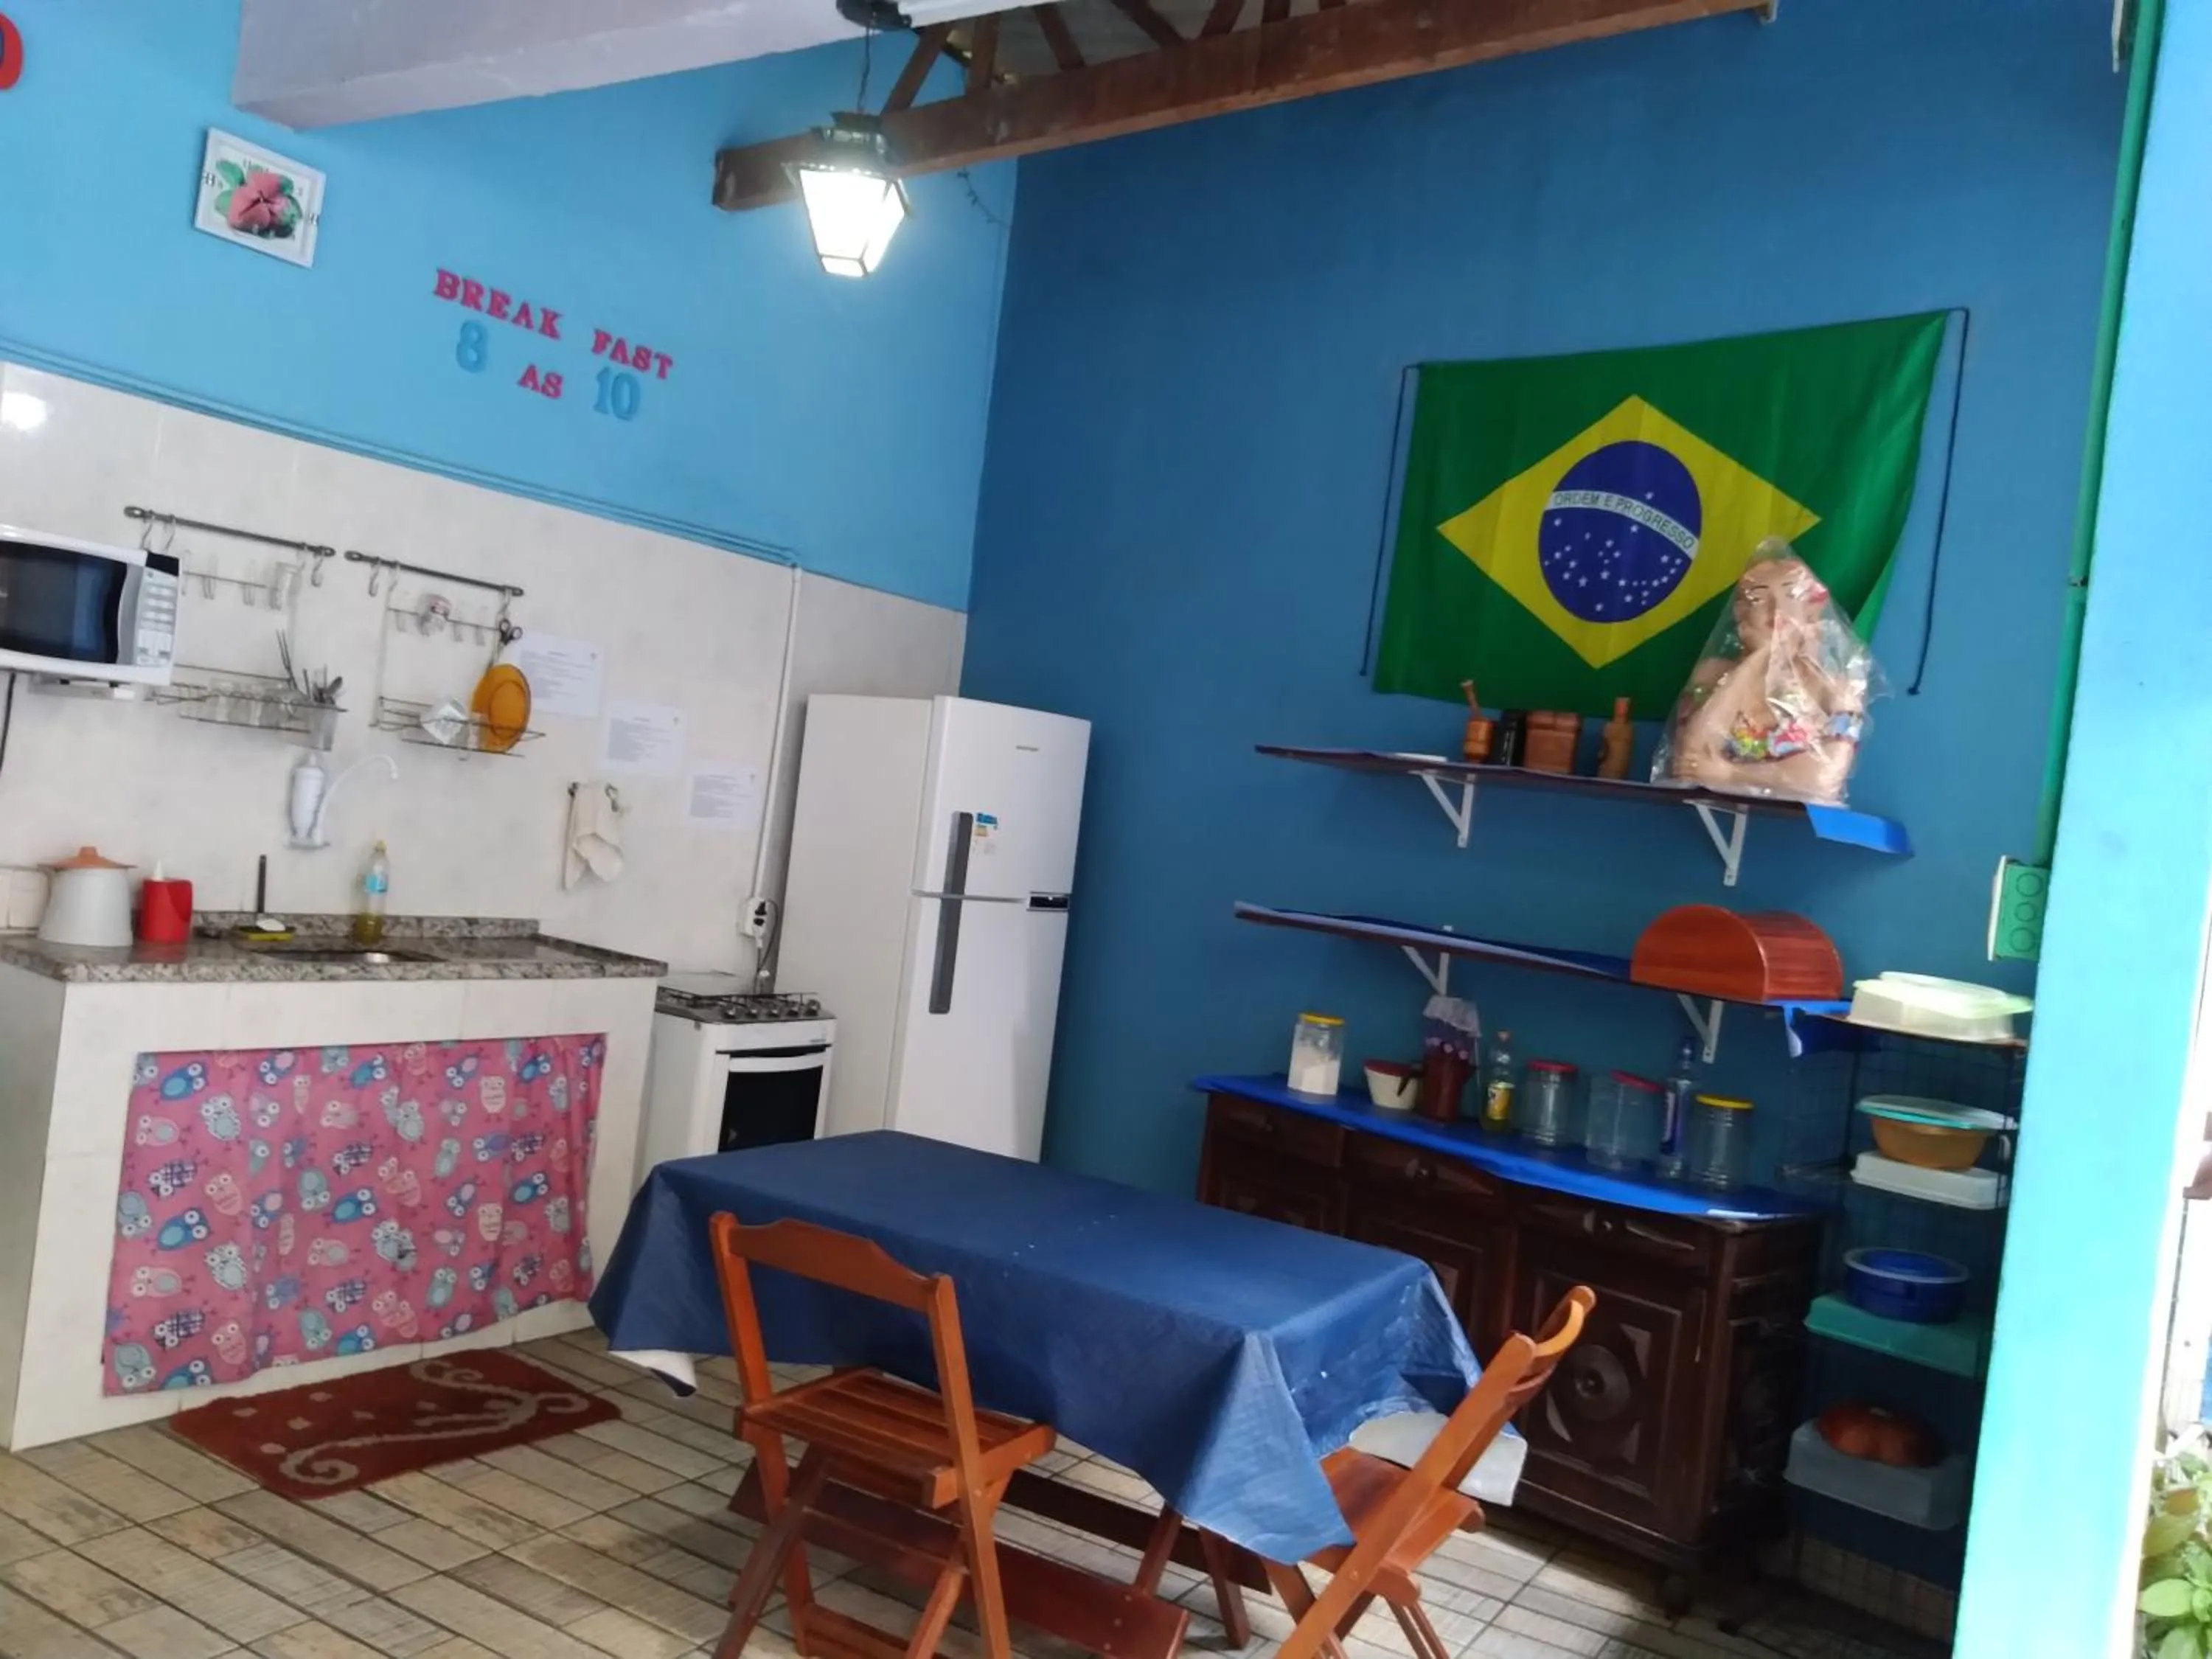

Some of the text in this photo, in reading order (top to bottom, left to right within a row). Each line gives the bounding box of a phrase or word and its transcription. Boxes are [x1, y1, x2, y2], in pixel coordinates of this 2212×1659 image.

[434, 268, 673, 380] BREAK FAST
[456, 318, 641, 422] 8 AS 10
[1554, 493, 1695, 549] ORDEM E PROGRESSO
